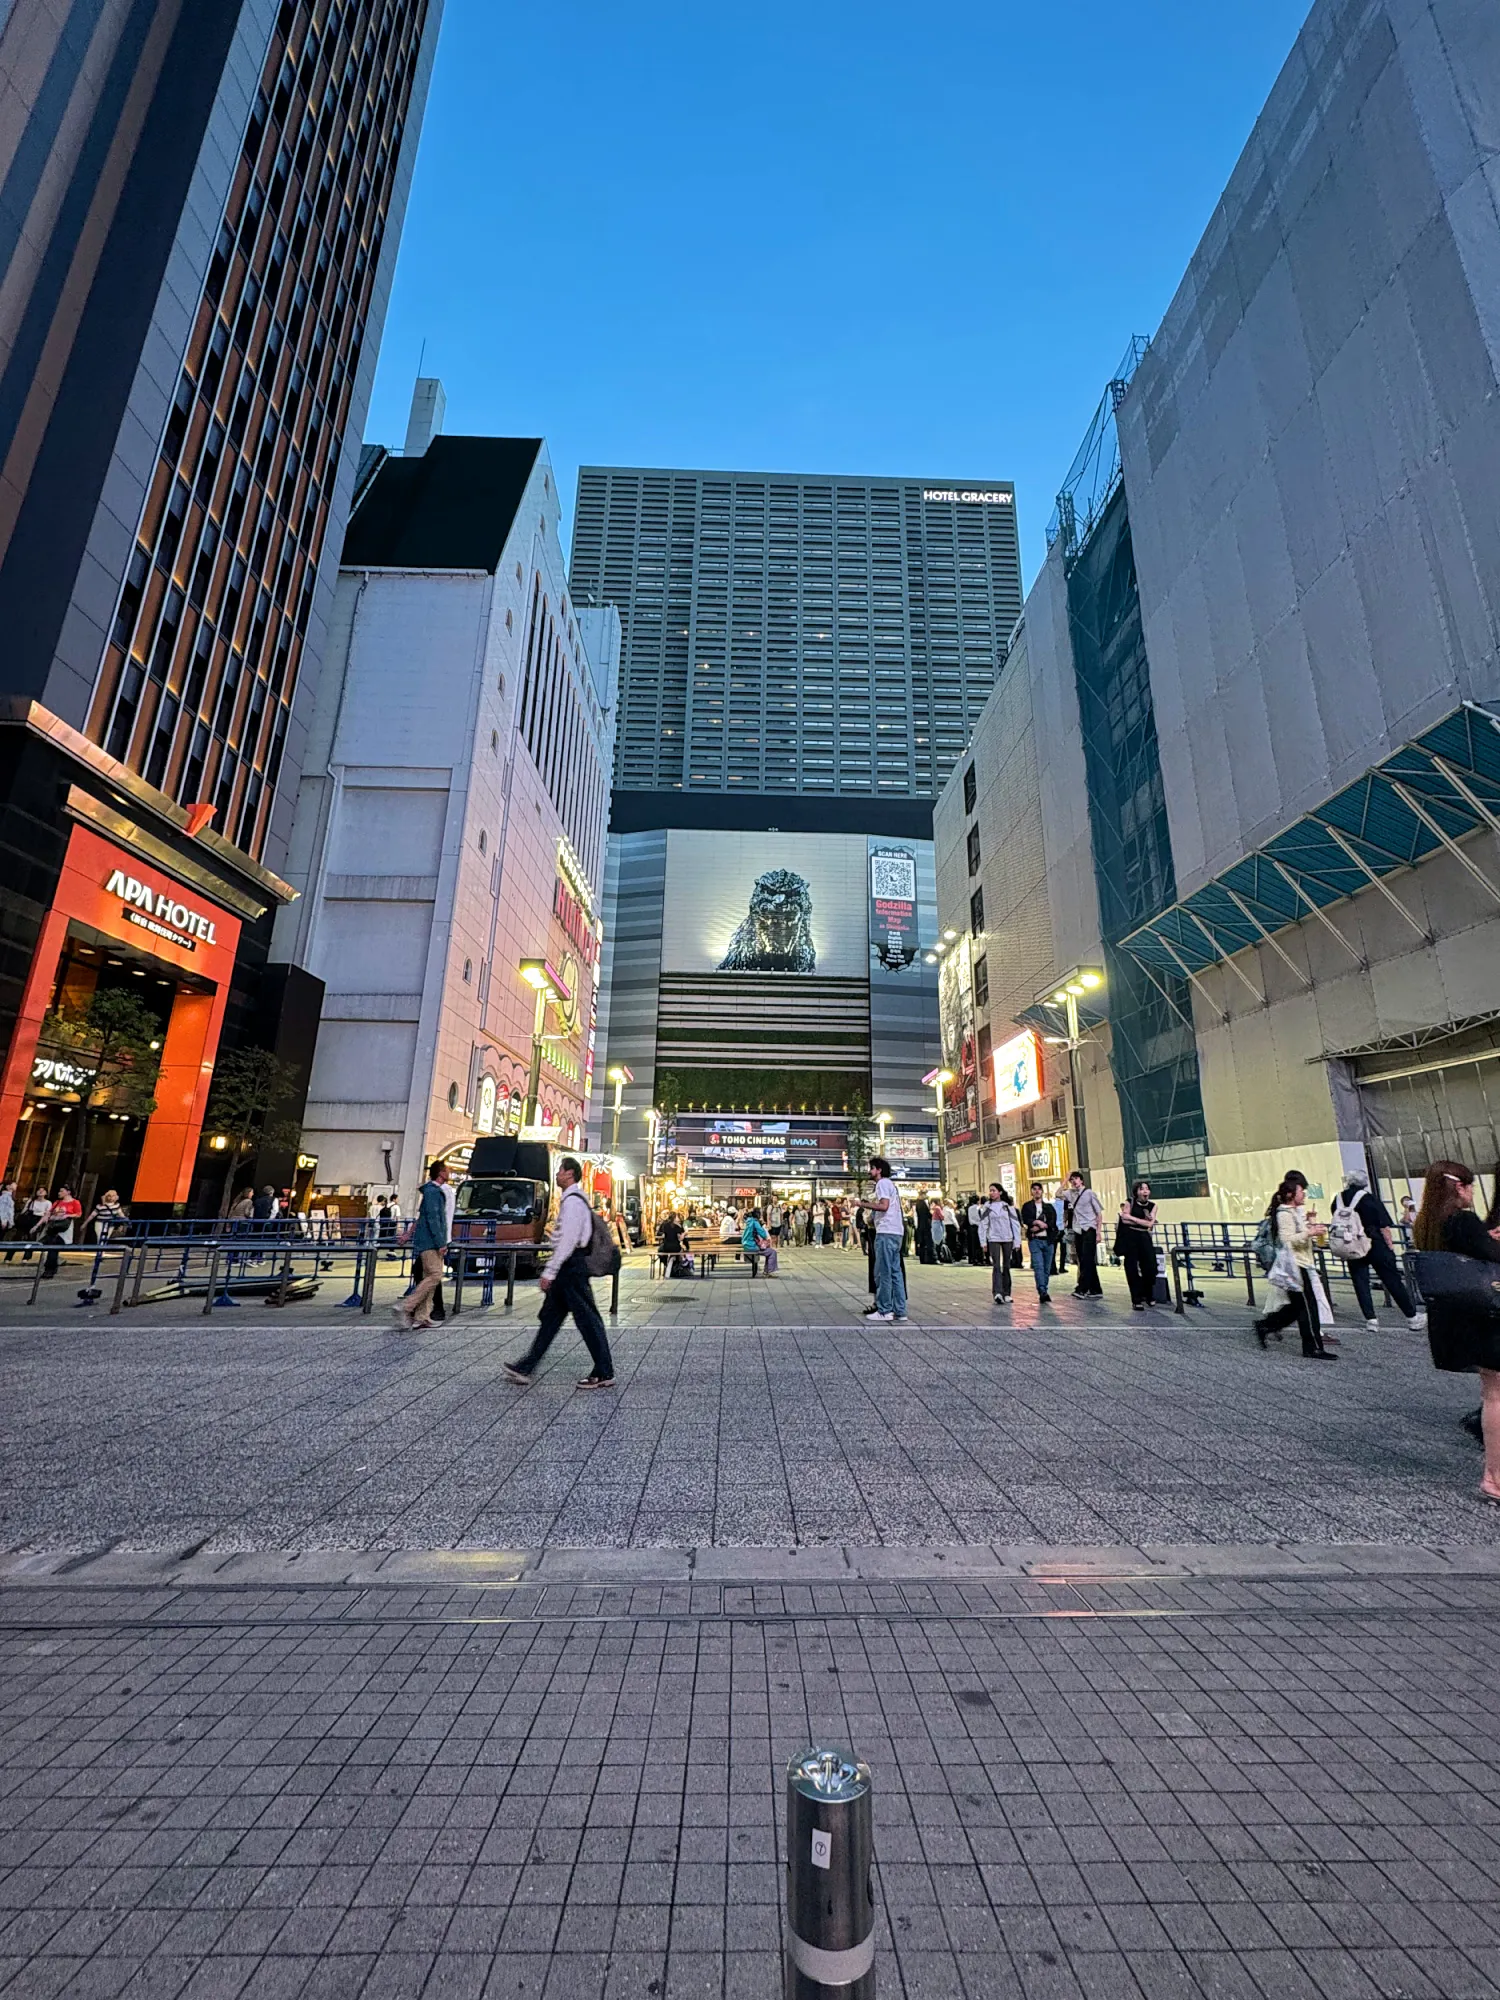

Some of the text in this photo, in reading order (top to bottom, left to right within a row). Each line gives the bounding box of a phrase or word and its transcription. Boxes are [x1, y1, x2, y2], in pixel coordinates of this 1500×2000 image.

[923, 491, 1012, 503] HOTEL GRACERY
[105, 869, 217, 945] APA HOTEL
[876, 900, 912, 910] Godzilla
[721, 1135, 786, 1145] TOHO CINEMAS
[790, 1138, 818, 1146] IMAX
